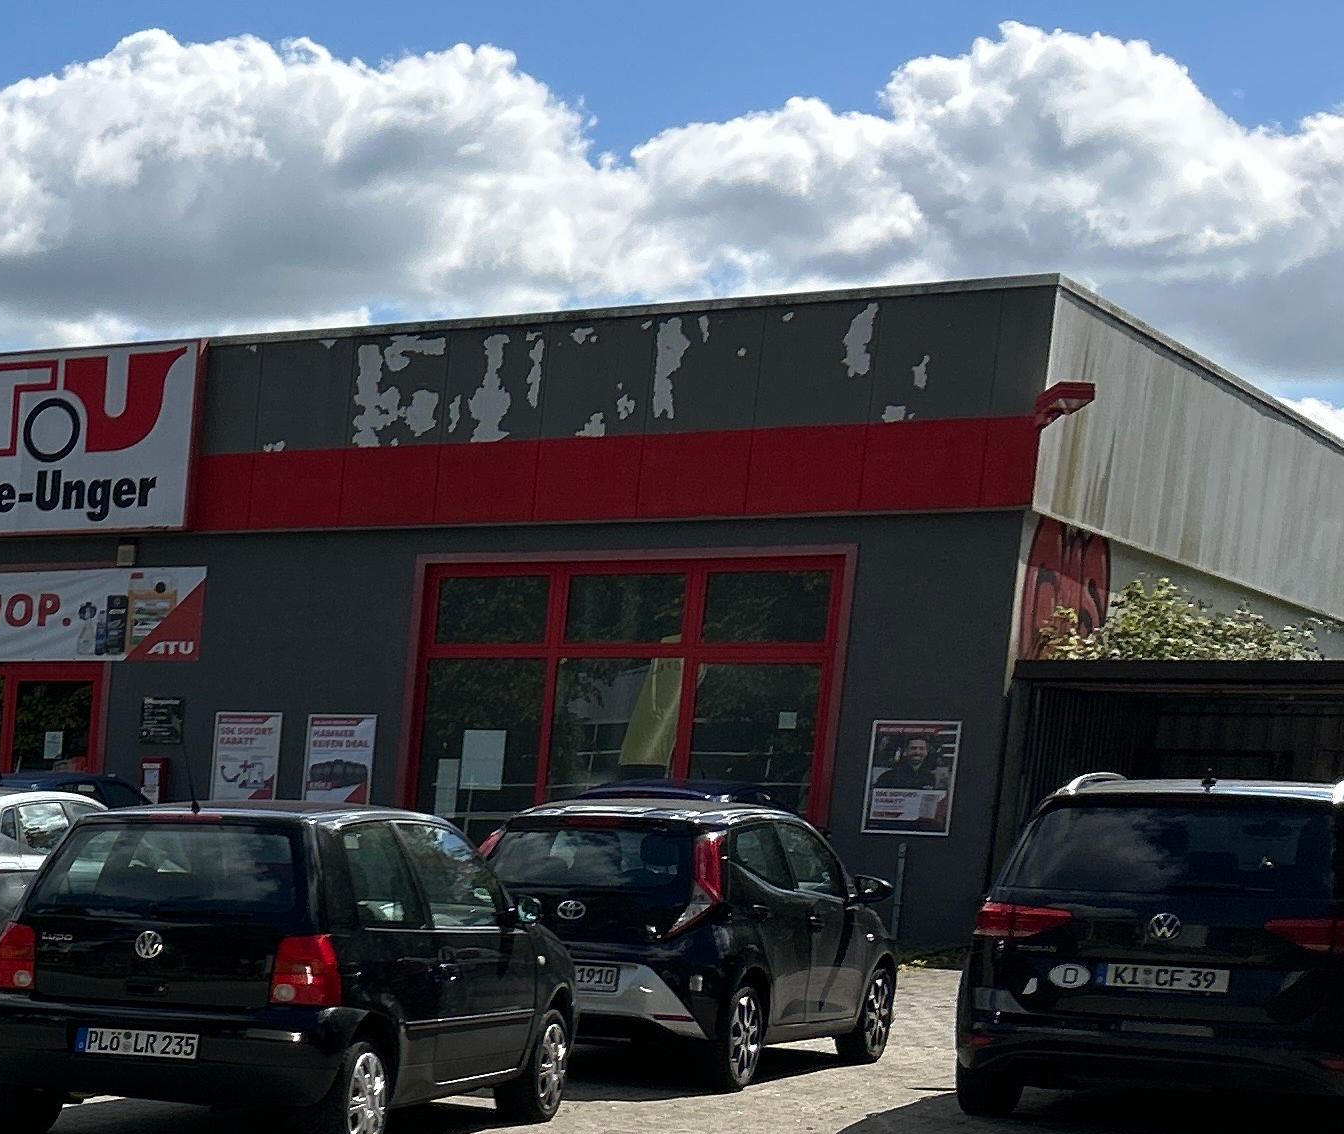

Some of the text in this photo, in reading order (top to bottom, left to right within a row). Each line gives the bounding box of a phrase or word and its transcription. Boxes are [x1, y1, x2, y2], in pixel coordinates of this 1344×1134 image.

[145, 640, 195, 655] ATU
[577, 967, 614, 985] 1910
[1062, 967, 1078, 984] D
[1112, 966, 1216, 989] KI CF 39
[87, 1030, 196, 1056] PLÖ LR 235
